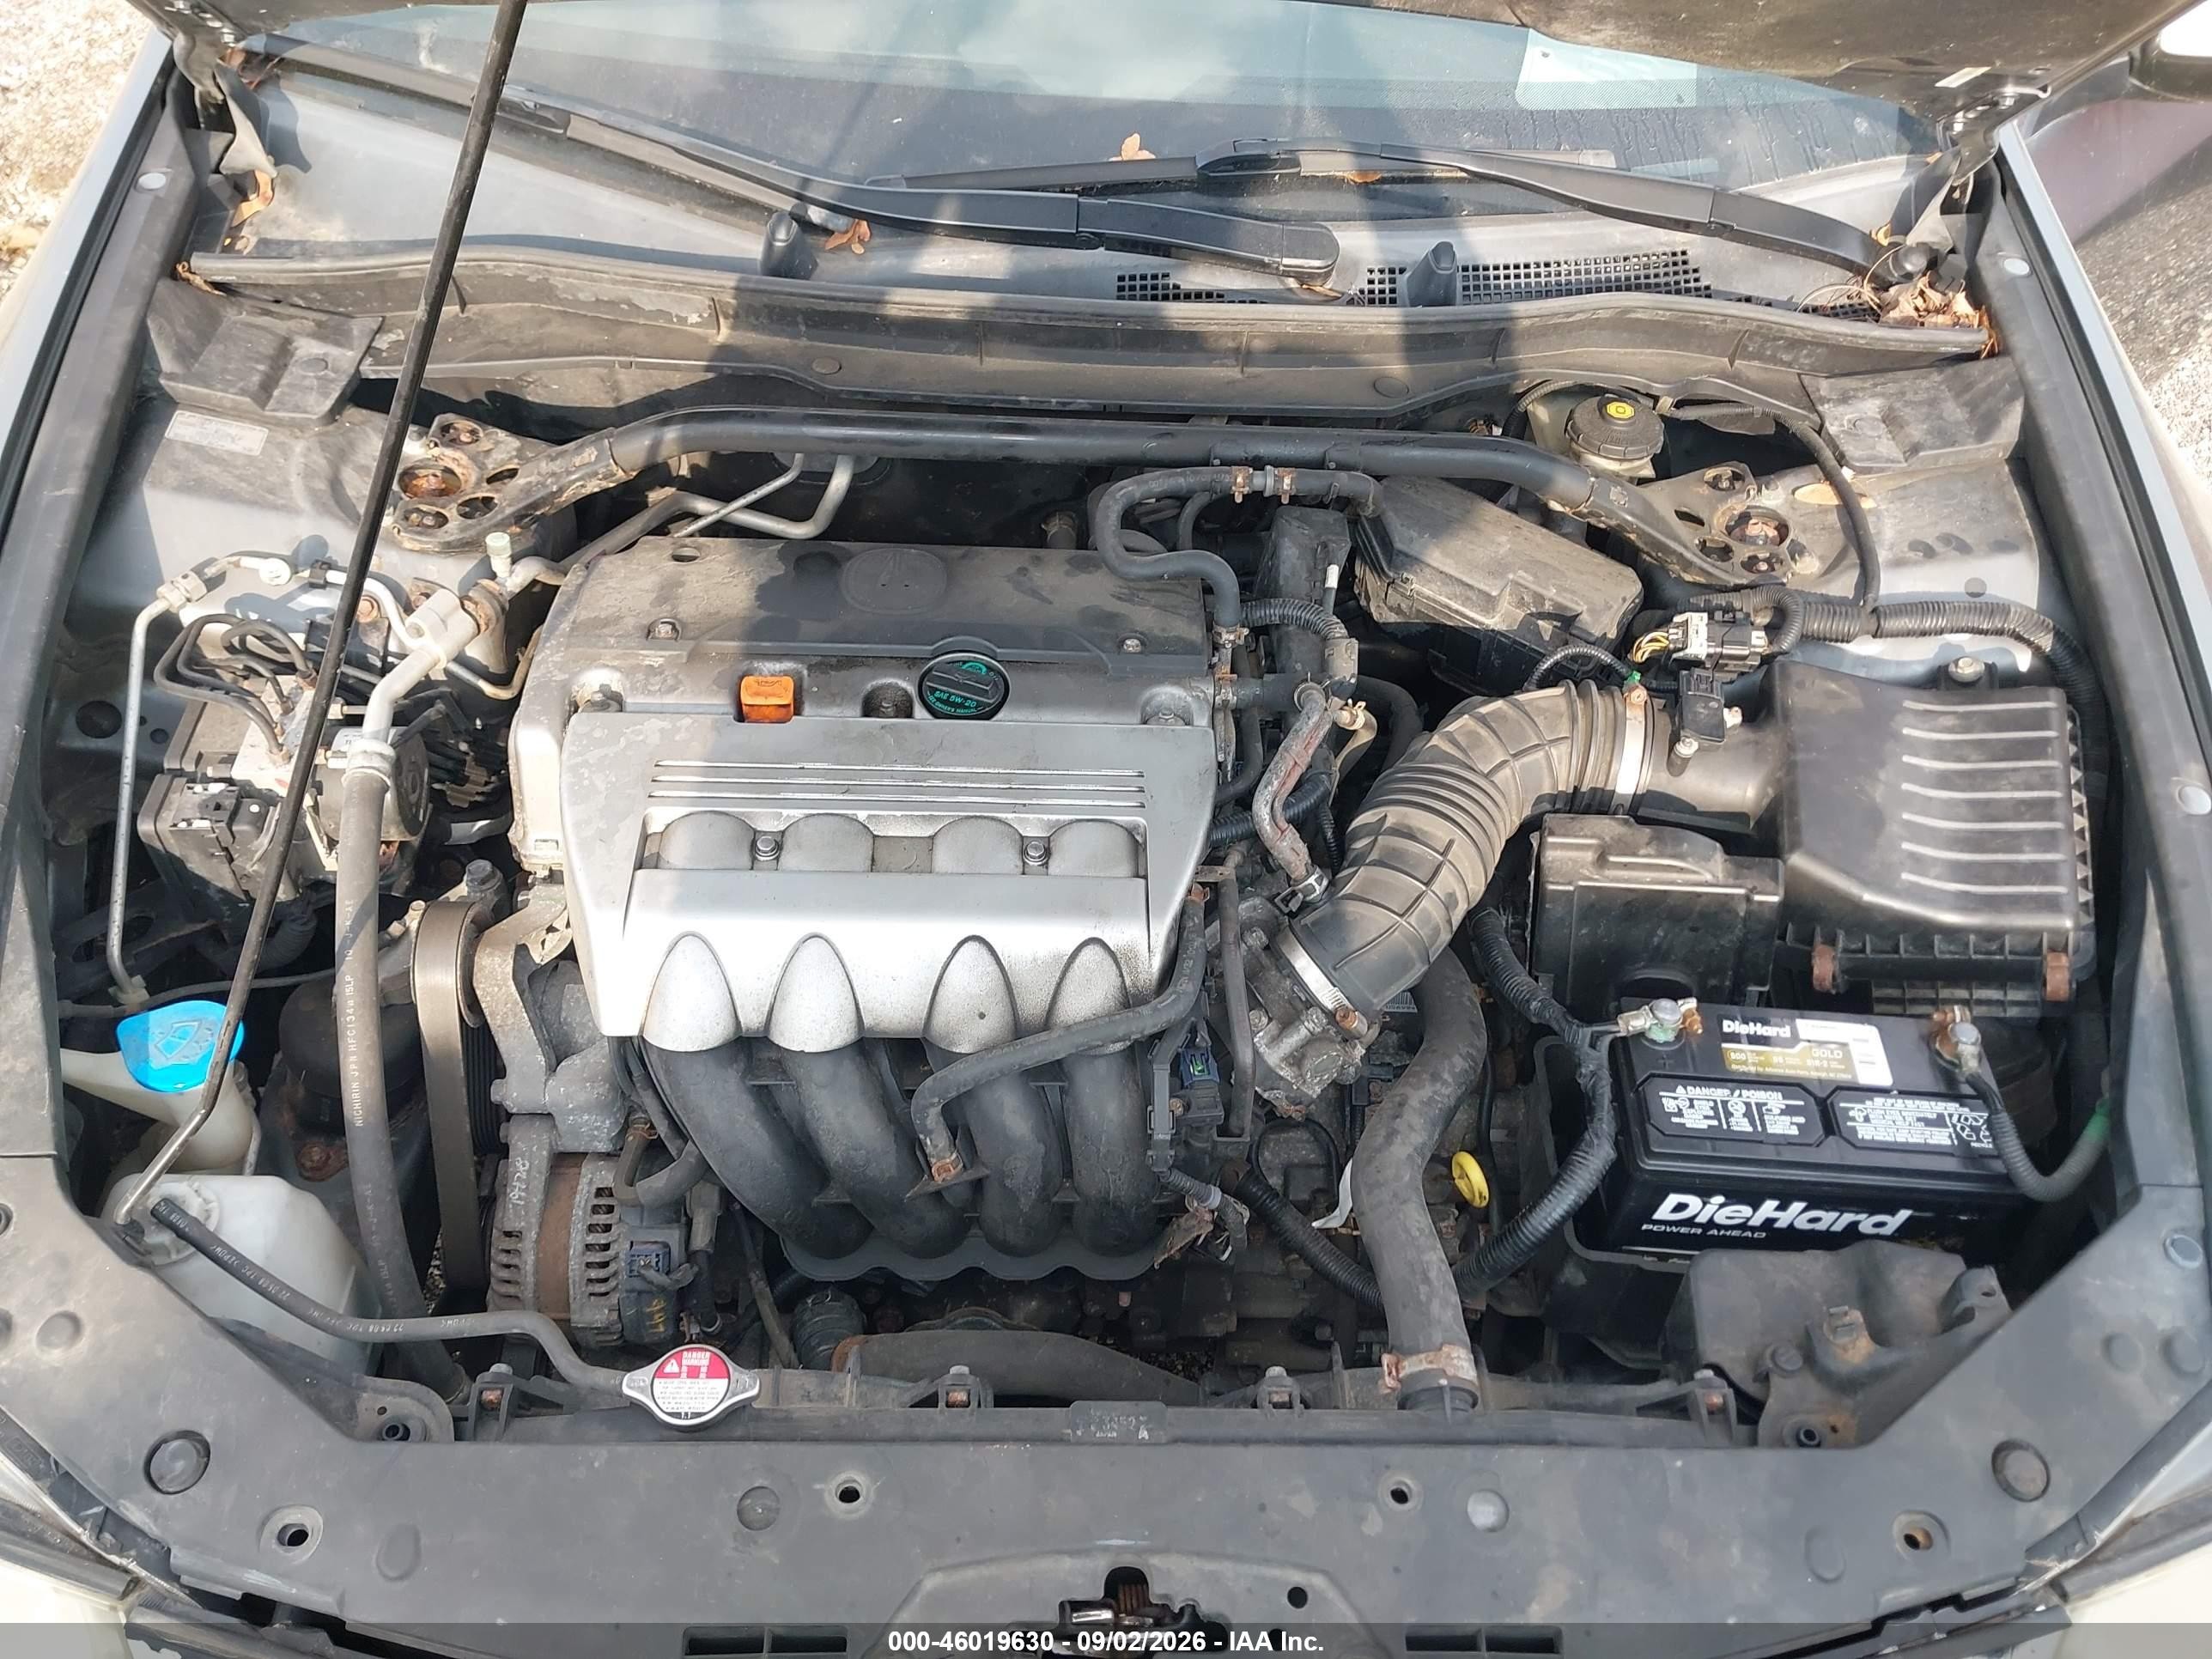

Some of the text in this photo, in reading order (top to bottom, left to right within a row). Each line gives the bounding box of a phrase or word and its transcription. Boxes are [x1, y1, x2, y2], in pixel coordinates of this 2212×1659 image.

[934, 690, 977, 708] SAE 5W-20
[1723, 1018, 1791, 1037] DieHard
[1811, 1048, 1843, 1060] GOLD
[349, 1055, 359, 1077] JPN
[1686, 1085, 1731, 1097] DANGER
[1741, 1090, 1783, 1101] POISON
[353, 1082, 364, 1127] NICHIRIN
[1651, 1192, 1913, 1237] DieHard
[1642, 1224, 1767, 1238] POWER AHEAD
